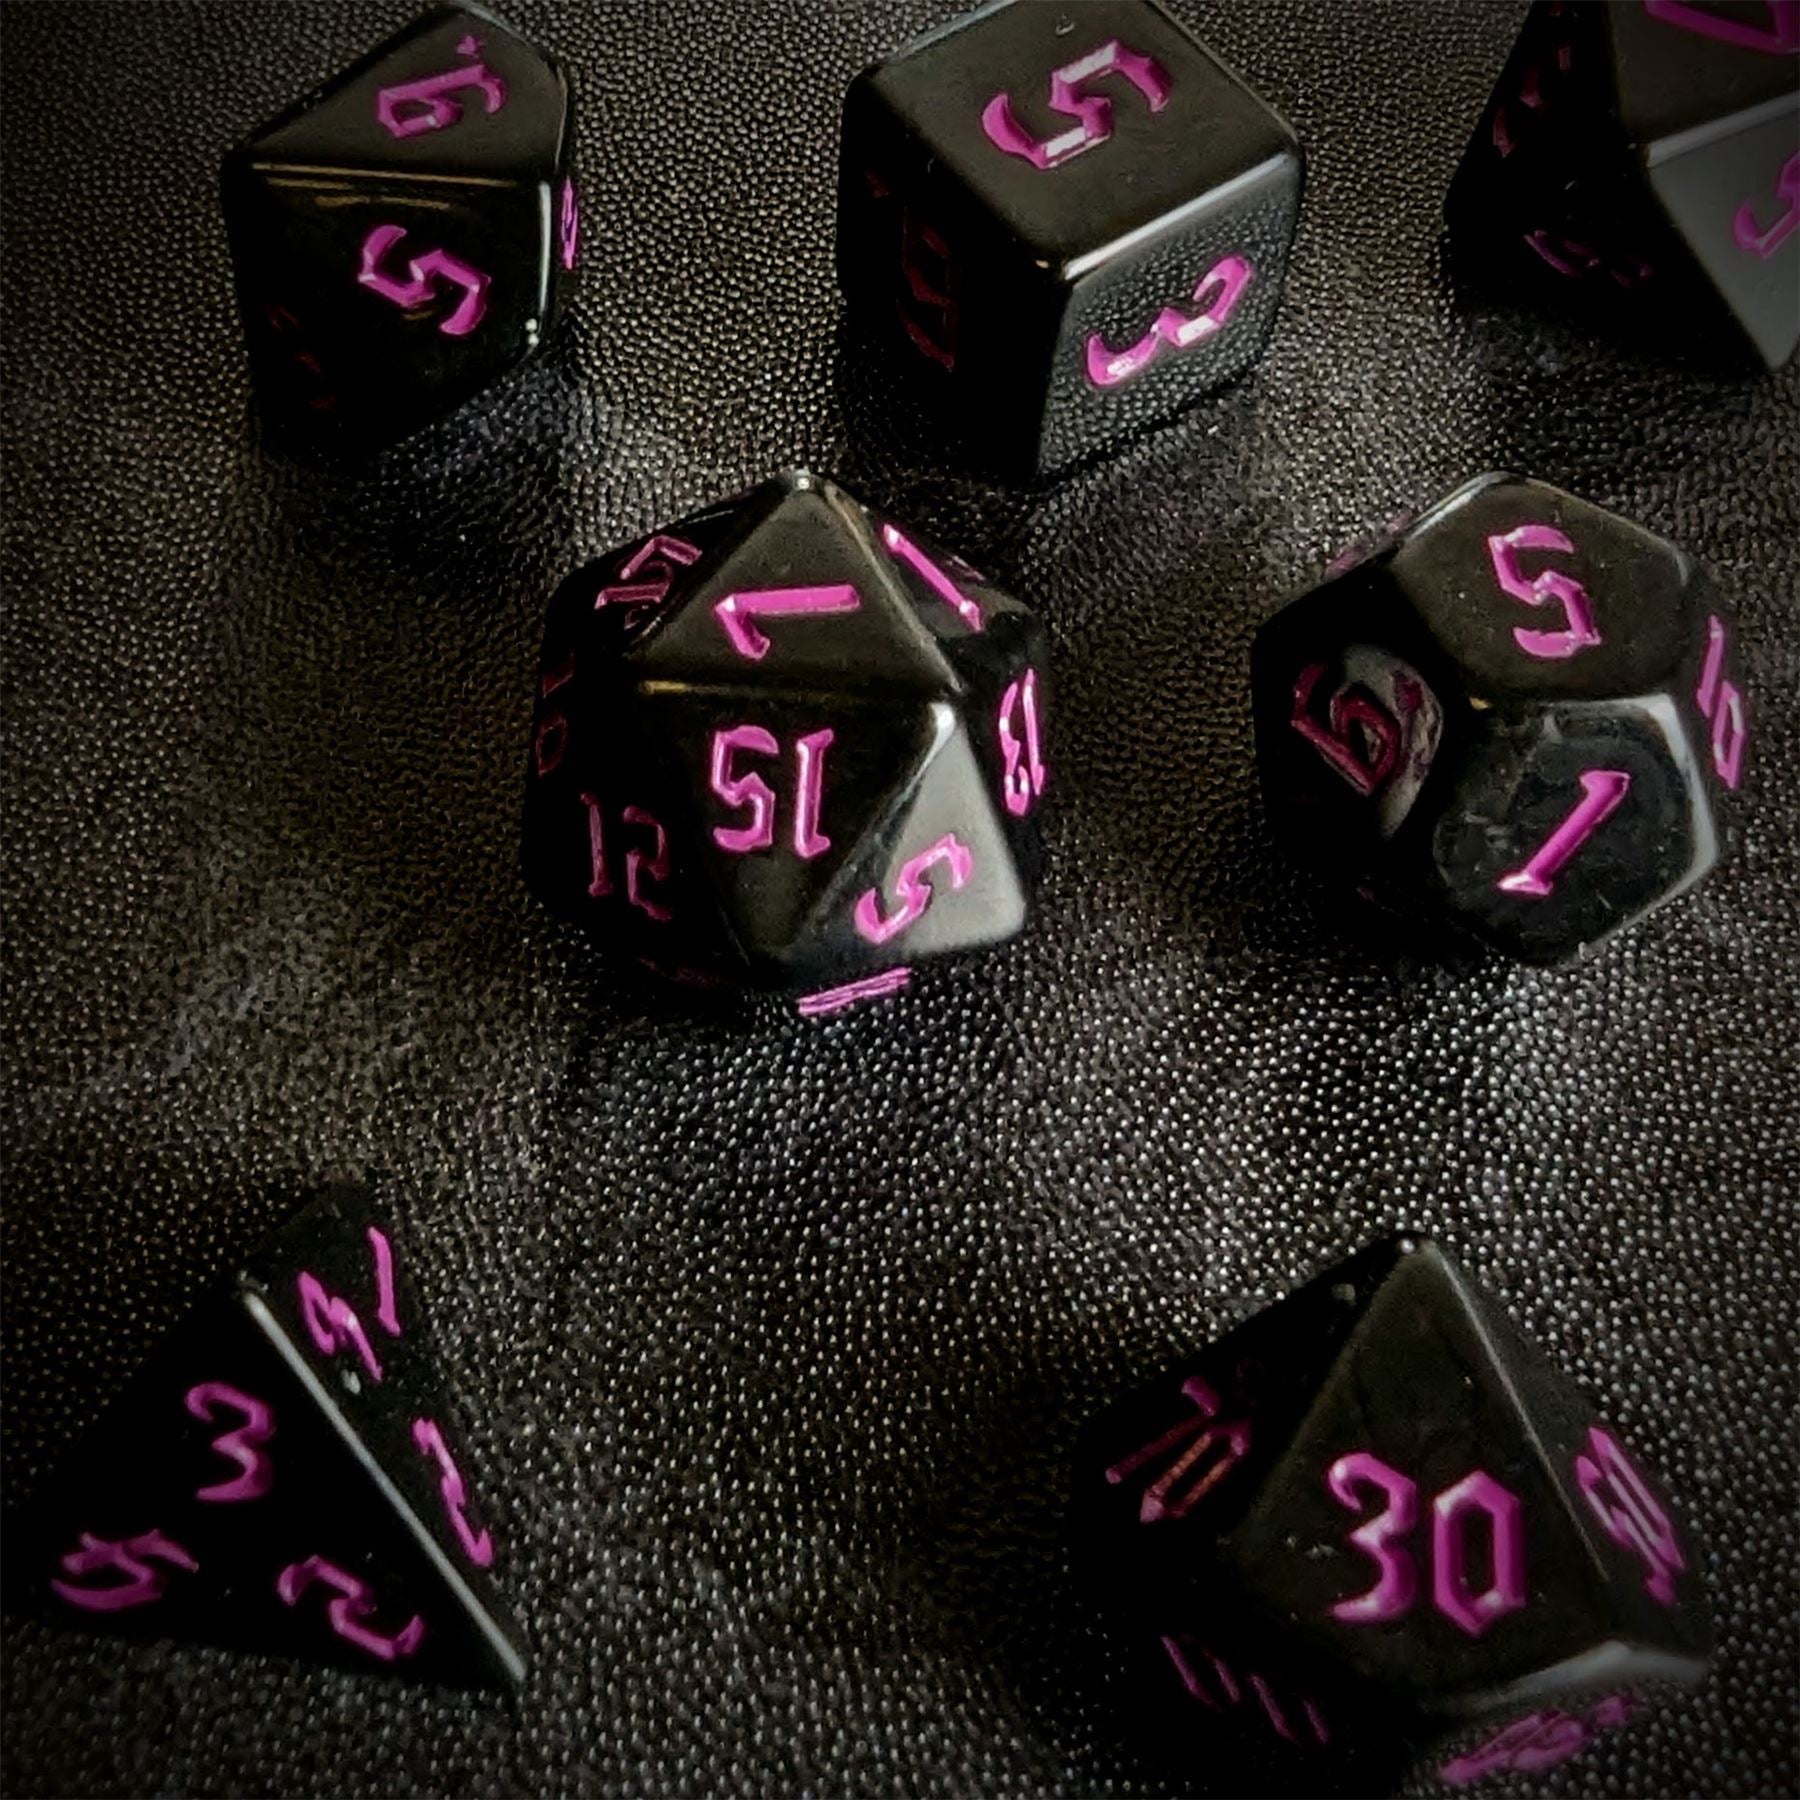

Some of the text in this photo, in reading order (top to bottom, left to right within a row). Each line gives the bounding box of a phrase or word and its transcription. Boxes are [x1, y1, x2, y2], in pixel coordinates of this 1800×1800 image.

[980, 40, 1171, 170] 5
[357, 222, 492, 337] 5
[1084, 254, 1254, 388] 3
[1487, 524, 1600, 660] 5
[577, 788, 674, 924] 12
[708, 723, 837, 860] 15
[1499, 768, 1631, 897] 1
[854, 832, 973, 944] 5
[184, 1380, 276, 1503] 3
[274, 1554, 428, 1661] 2
[1326, 1450, 1529, 1639] 30
